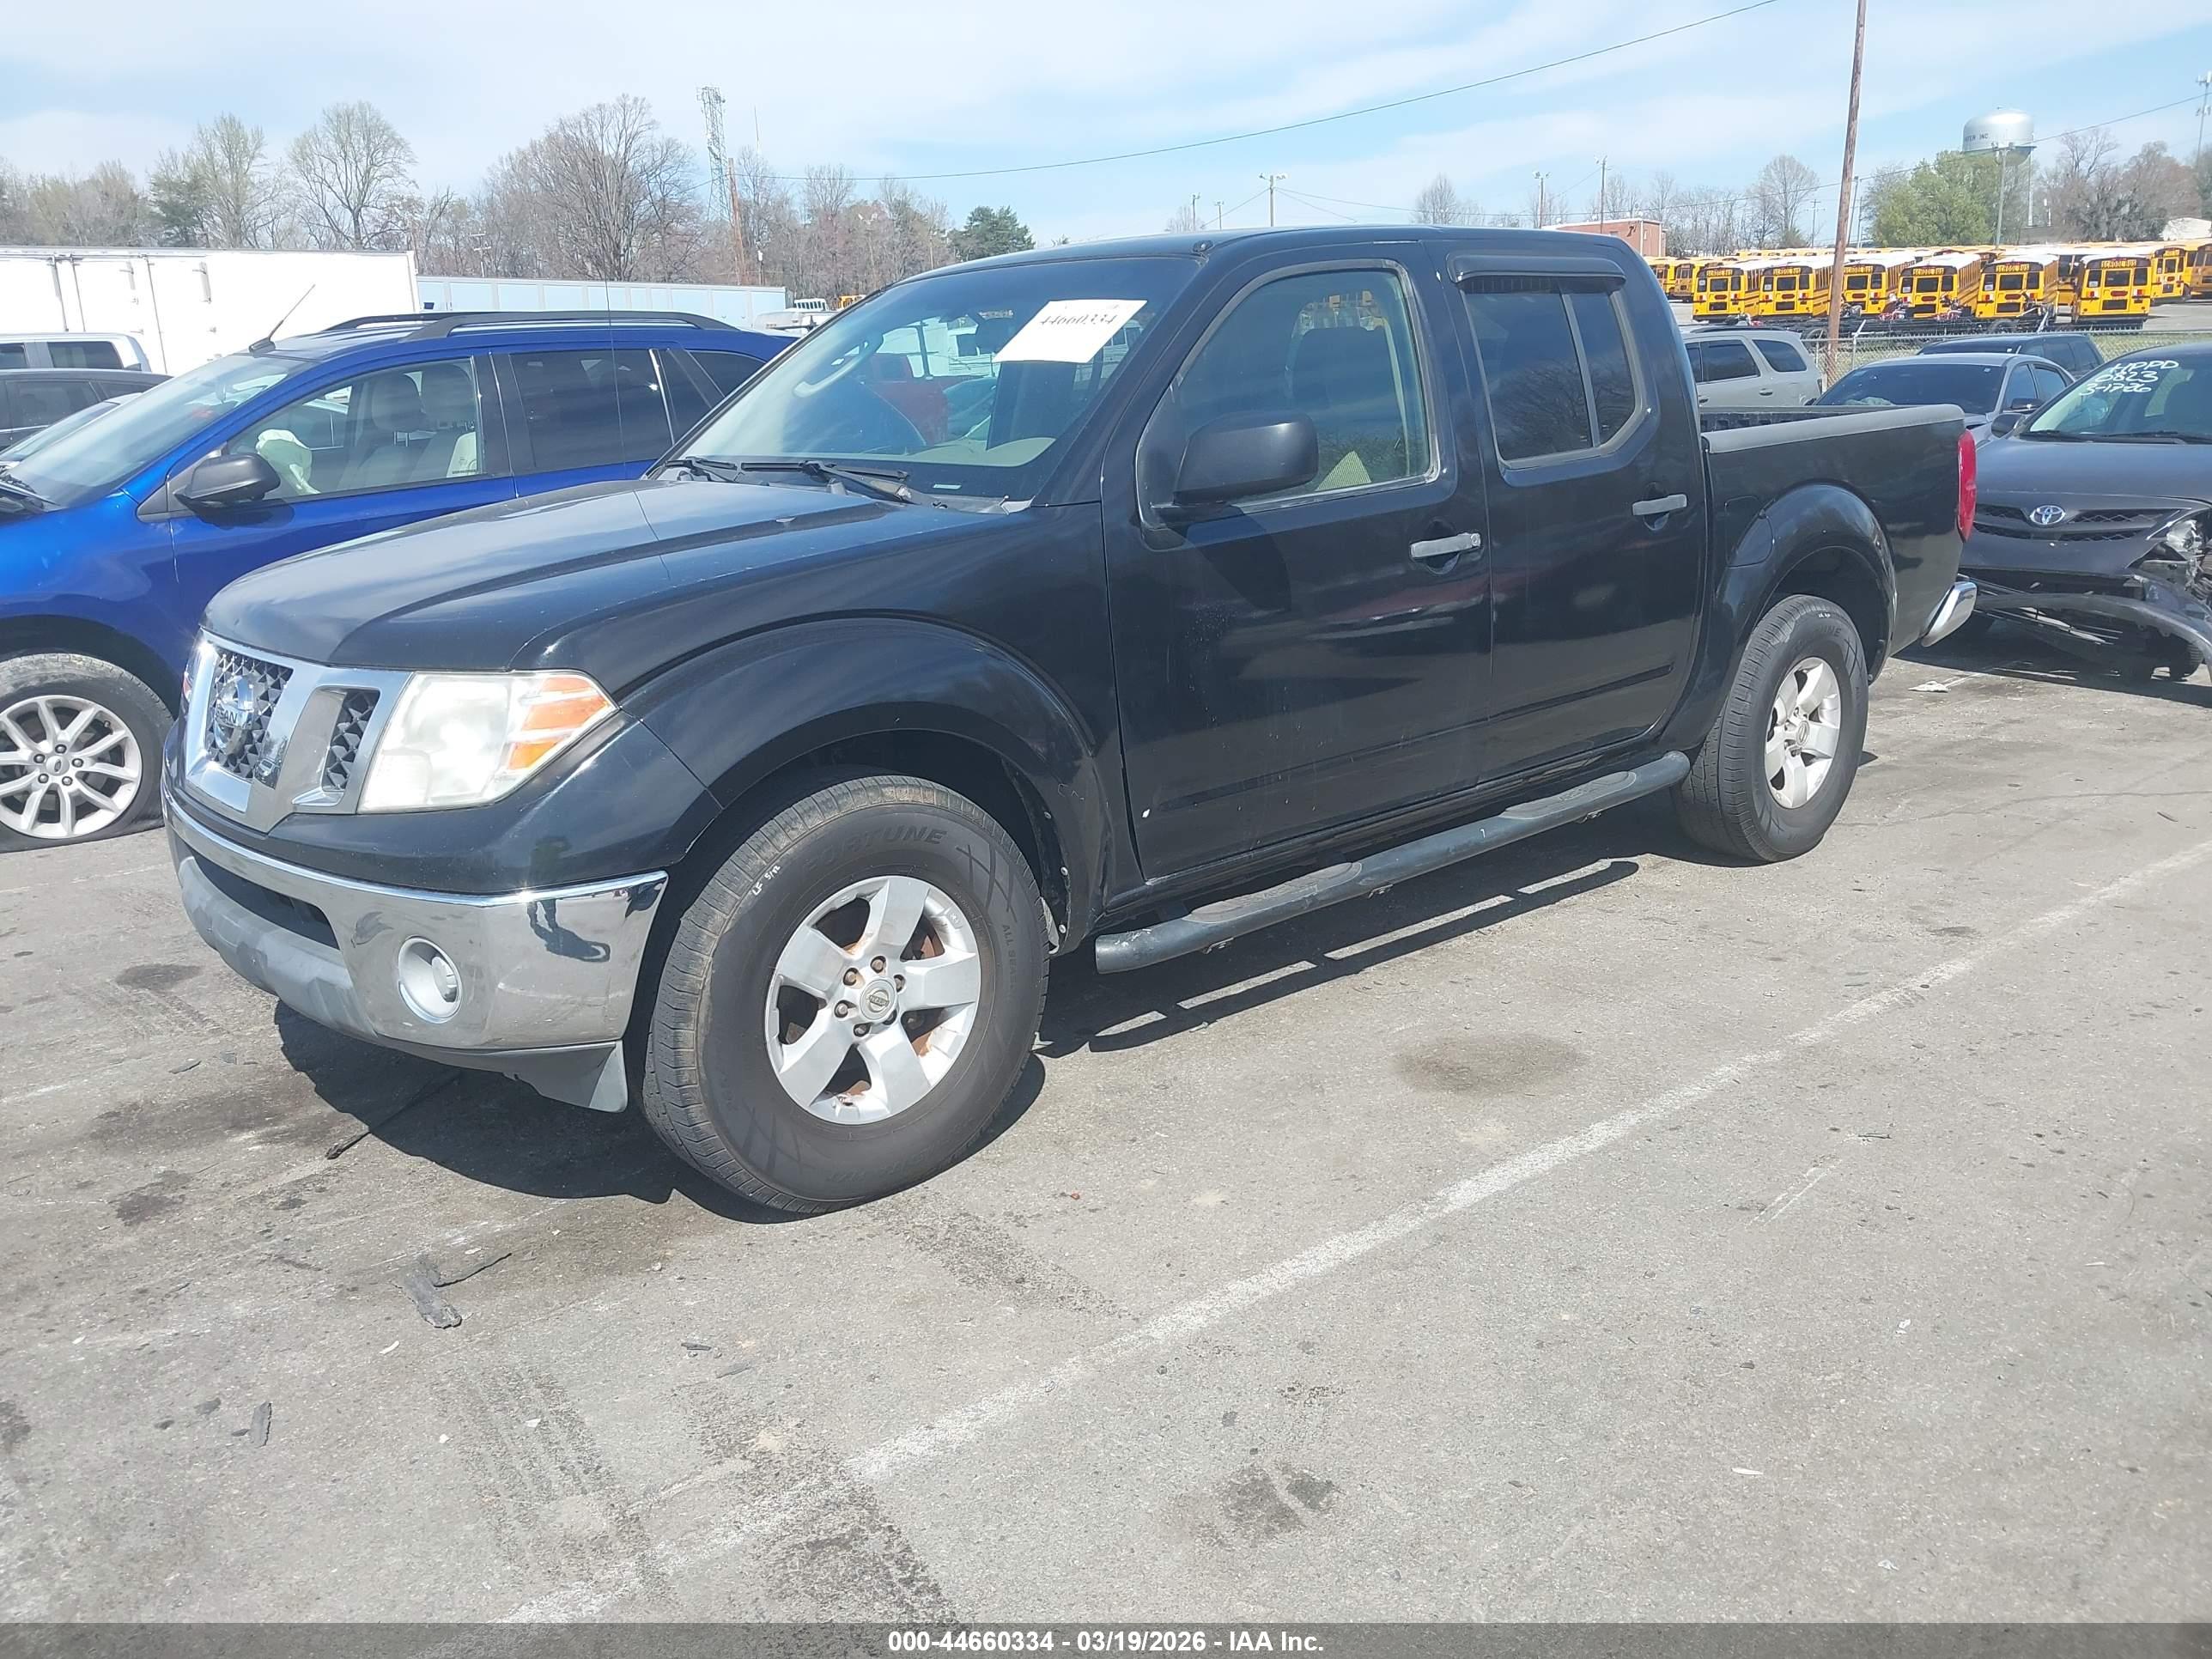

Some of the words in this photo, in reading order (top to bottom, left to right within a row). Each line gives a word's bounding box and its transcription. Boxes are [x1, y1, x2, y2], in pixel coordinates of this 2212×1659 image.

[2101, 259, 2125, 268] SCHOOL
[2126, 258, 2136, 267] BUS
[2094, 371, 2159, 383] 0823
